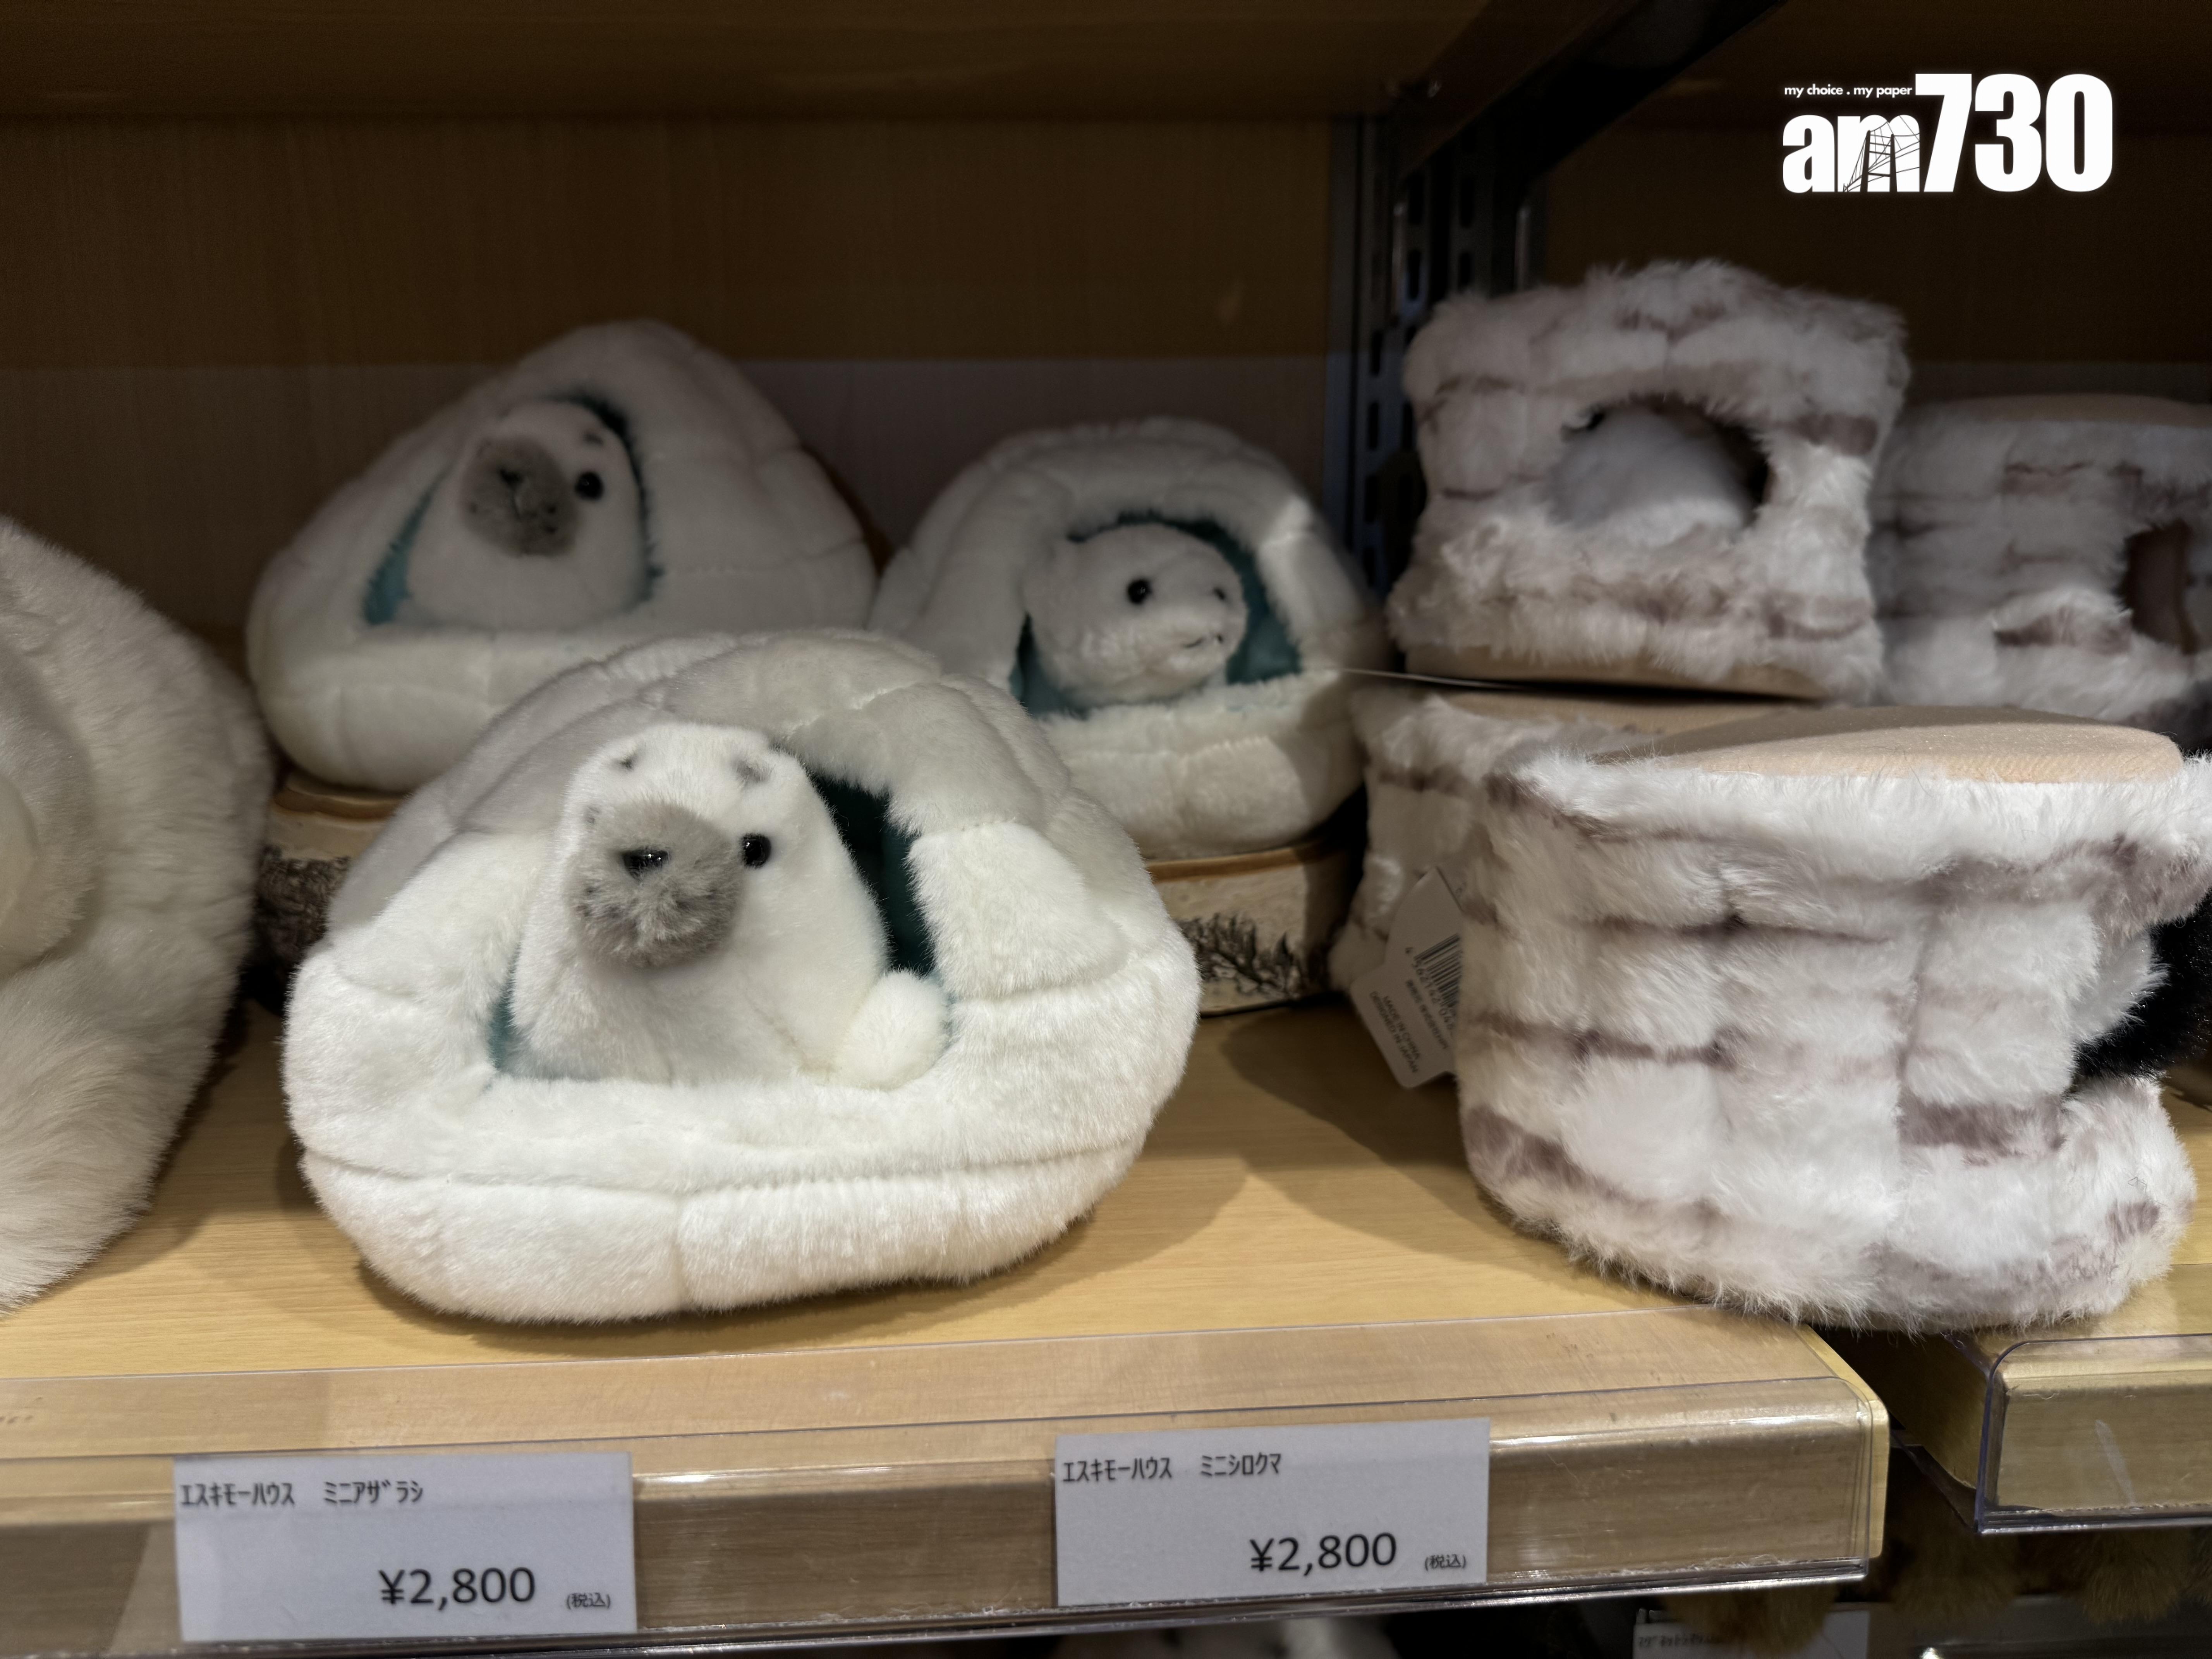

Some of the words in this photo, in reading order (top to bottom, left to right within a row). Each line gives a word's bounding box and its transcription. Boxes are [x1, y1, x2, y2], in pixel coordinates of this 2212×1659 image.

[1382, 995, 1401, 1021] MADE
[1396, 1020, 1406, 1031] IN
[1401, 1031, 1422, 1060] CHINA
[1398, 1044, 1419, 1074] JAPAN
[1062, 1456, 1173, 1483] エスキモーハウス
[1200, 1451, 1282, 1477] ミニシロクマ
[1249, 1532, 1398, 1578] ¥2,800
[1424, 1554, 1467, 1571] (税込)
[378, 1566, 536, 1612] ¥2,800
[566, 1592, 611, 1610] (税込)
